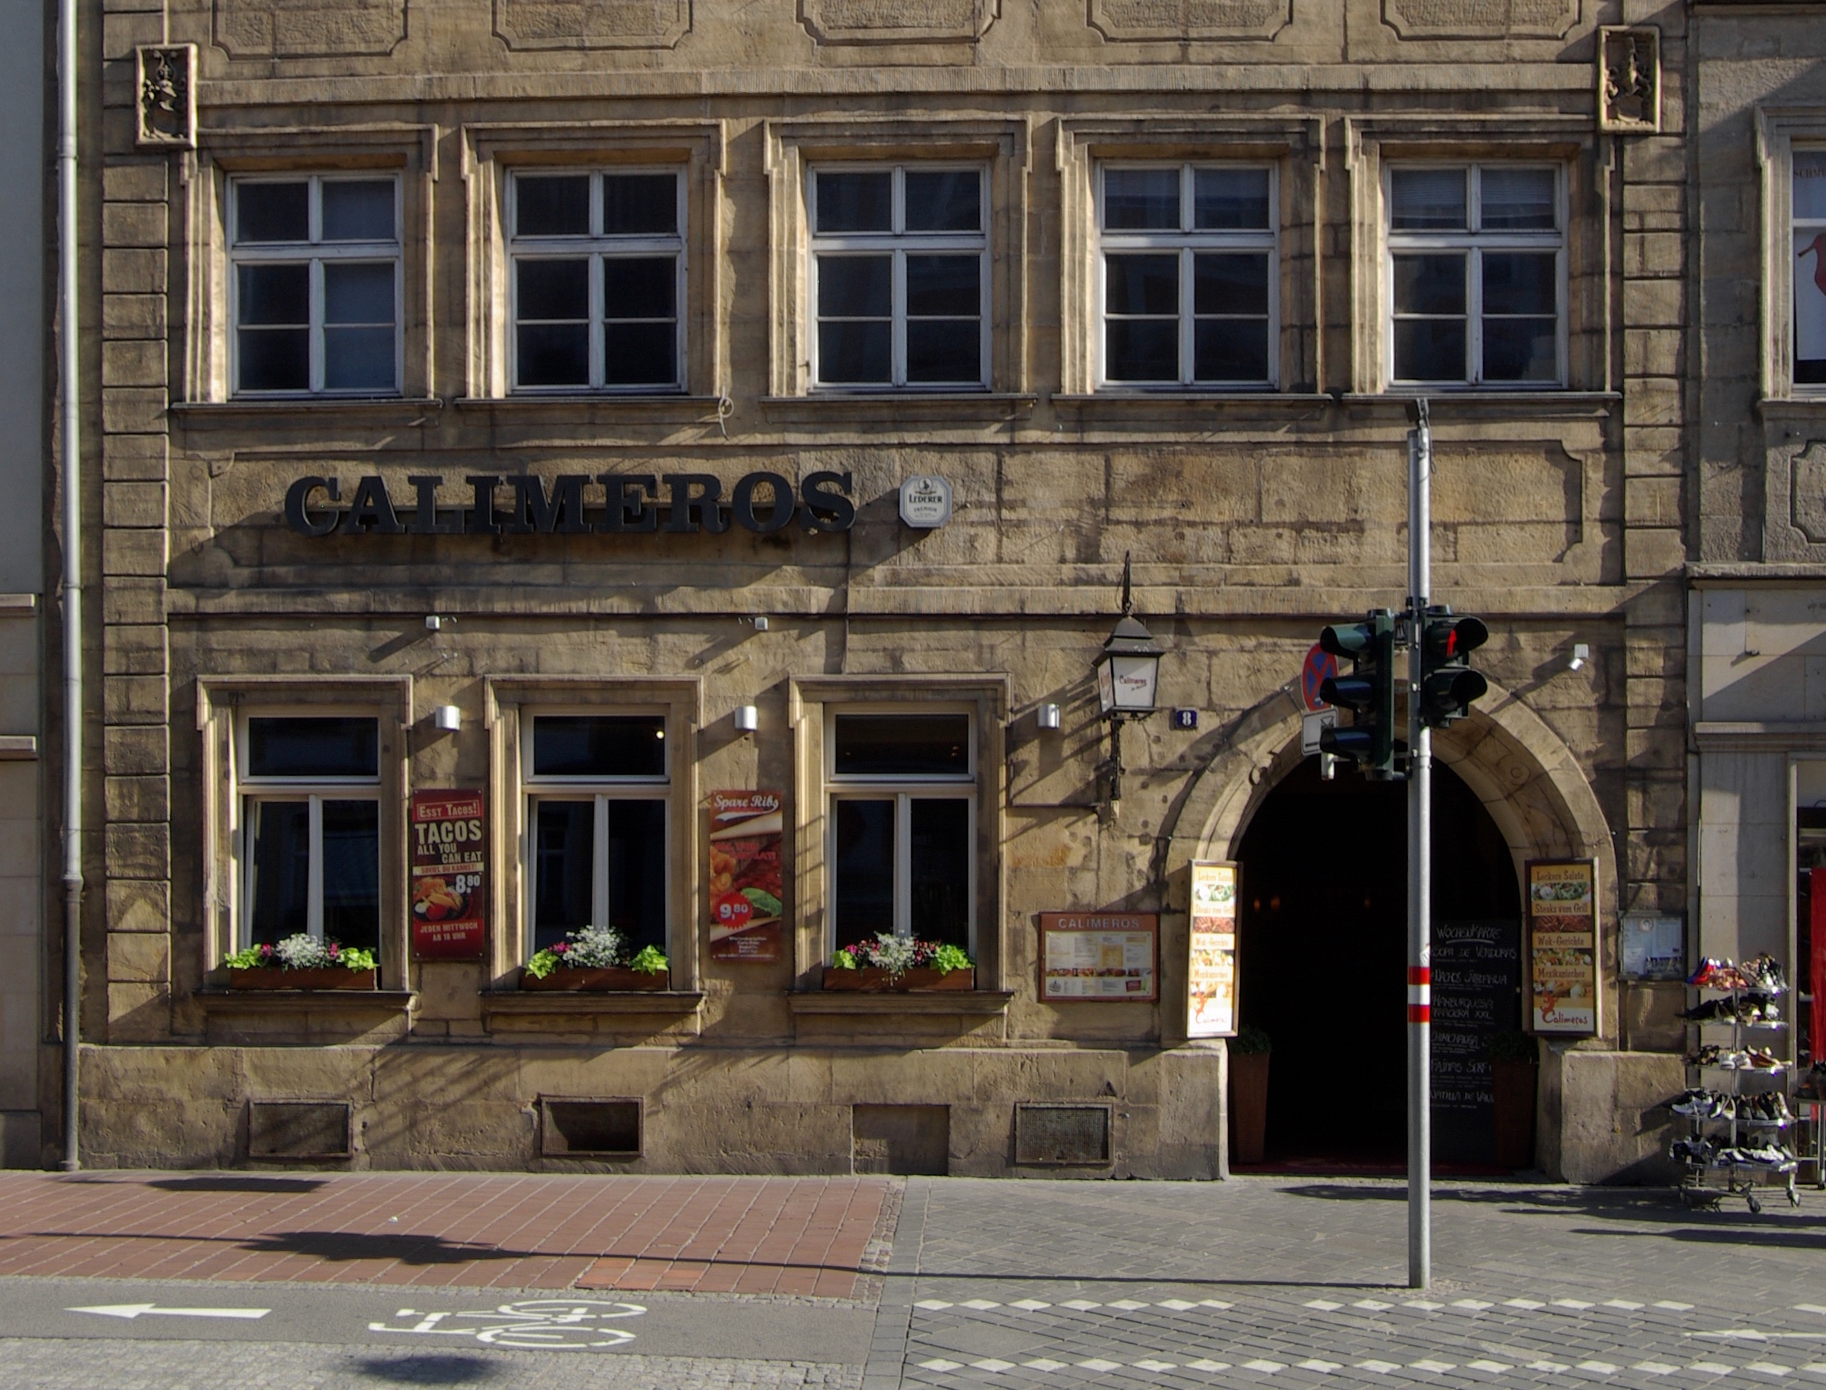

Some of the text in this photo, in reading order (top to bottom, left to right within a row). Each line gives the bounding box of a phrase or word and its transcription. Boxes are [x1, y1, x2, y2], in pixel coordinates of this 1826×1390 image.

[285, 470, 857, 536] CALIMEROS
[1182, 711, 1192, 726] 8
[714, 794, 779, 811] Spare Ribs
[414, 819, 482, 845] TACOS
[417, 842, 458, 856] ALL YOU
[441, 850, 482, 864] CAN EAT
[1536, 870, 1585, 881] Leckere Salate
[455, 874, 481, 894] 8.80
[719, 902, 749, 921] 9,80
[1534, 904, 1557, 914] Steaks
[420, 924, 441, 934] JEDEN
[1058, 918, 1140, 929] CALIMEROS
[1541, 1009, 1588, 1025] Calimeros
